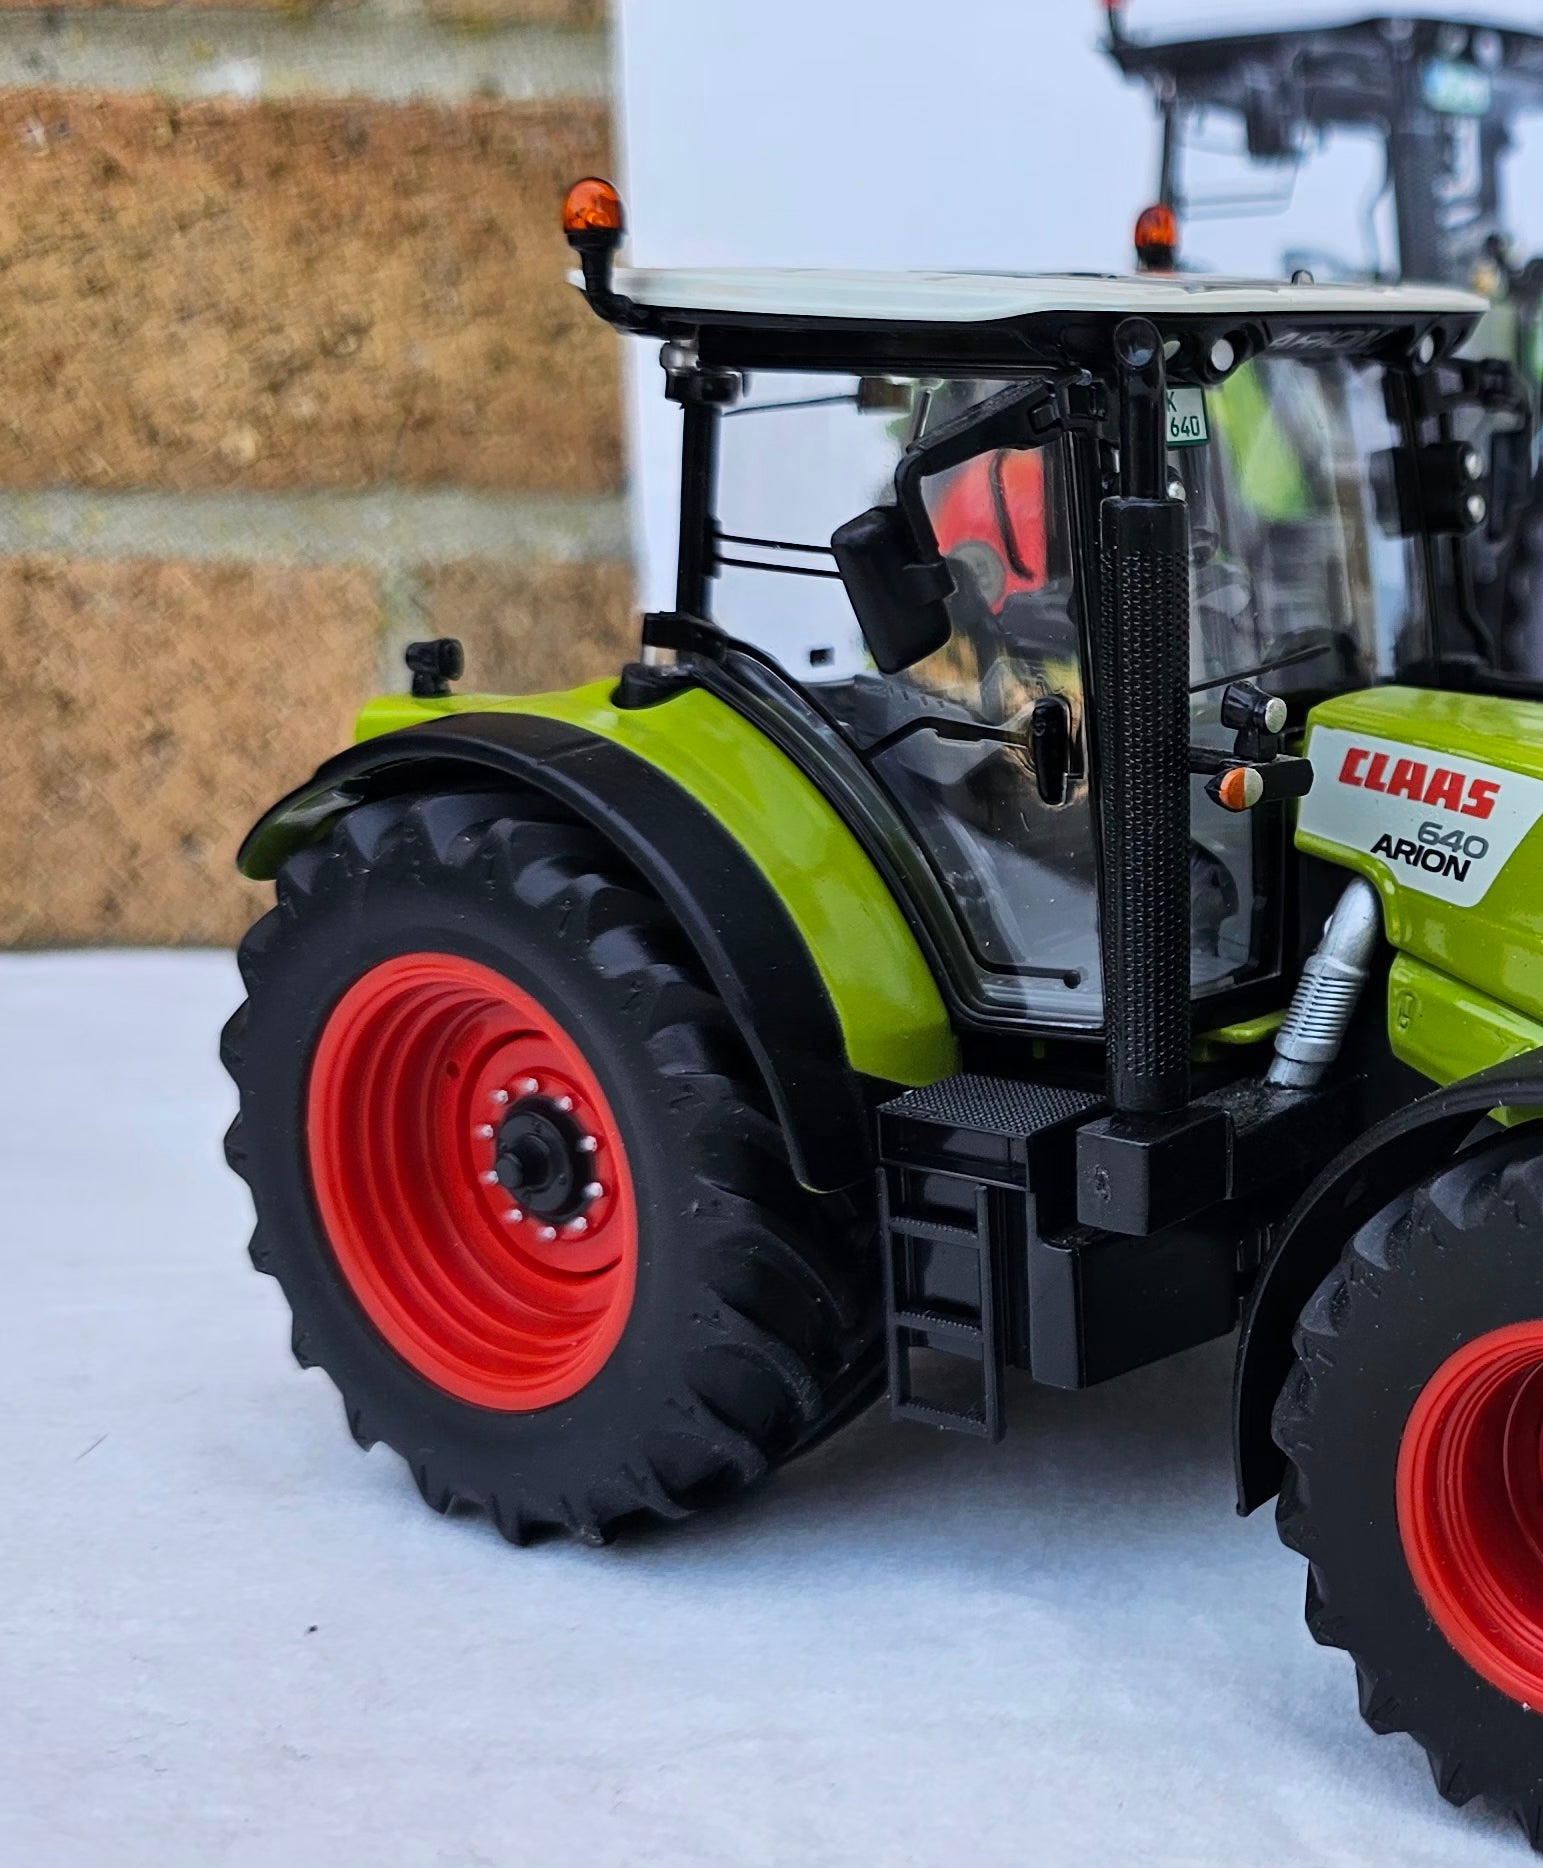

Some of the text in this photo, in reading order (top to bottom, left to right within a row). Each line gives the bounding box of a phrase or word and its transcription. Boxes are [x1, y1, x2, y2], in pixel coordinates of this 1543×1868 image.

[1170, 416, 1200, 437] 640
[1338, 747, 1501, 820] CLAAS
[1370, 833, 1471, 883] ARION
[1417, 821, 1489, 859] 640
